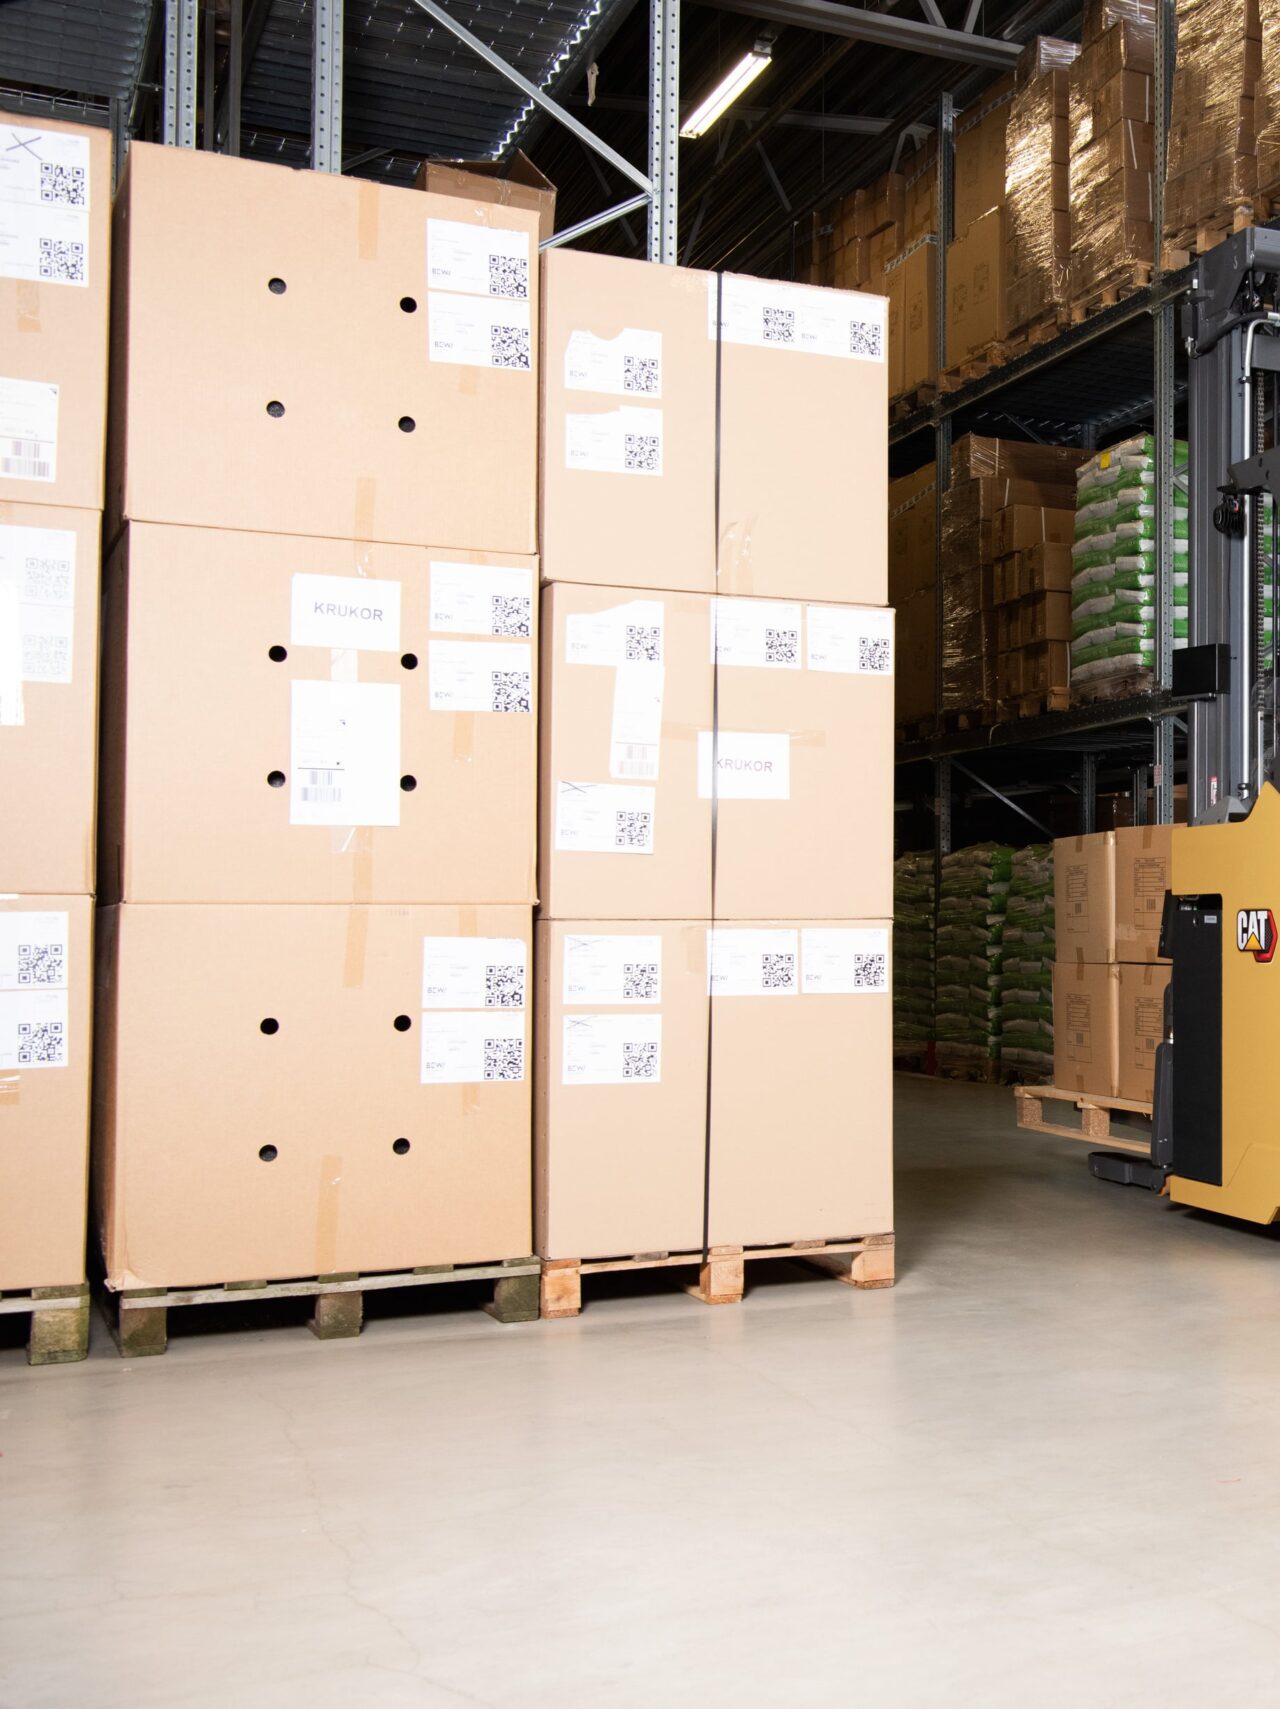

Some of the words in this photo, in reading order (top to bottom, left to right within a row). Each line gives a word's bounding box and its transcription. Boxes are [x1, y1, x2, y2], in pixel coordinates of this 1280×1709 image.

[313, 601, 383, 622] KRUKOR
[715, 757, 773, 773] KRUKOR
[1237, 909, 1268, 951] CAT
